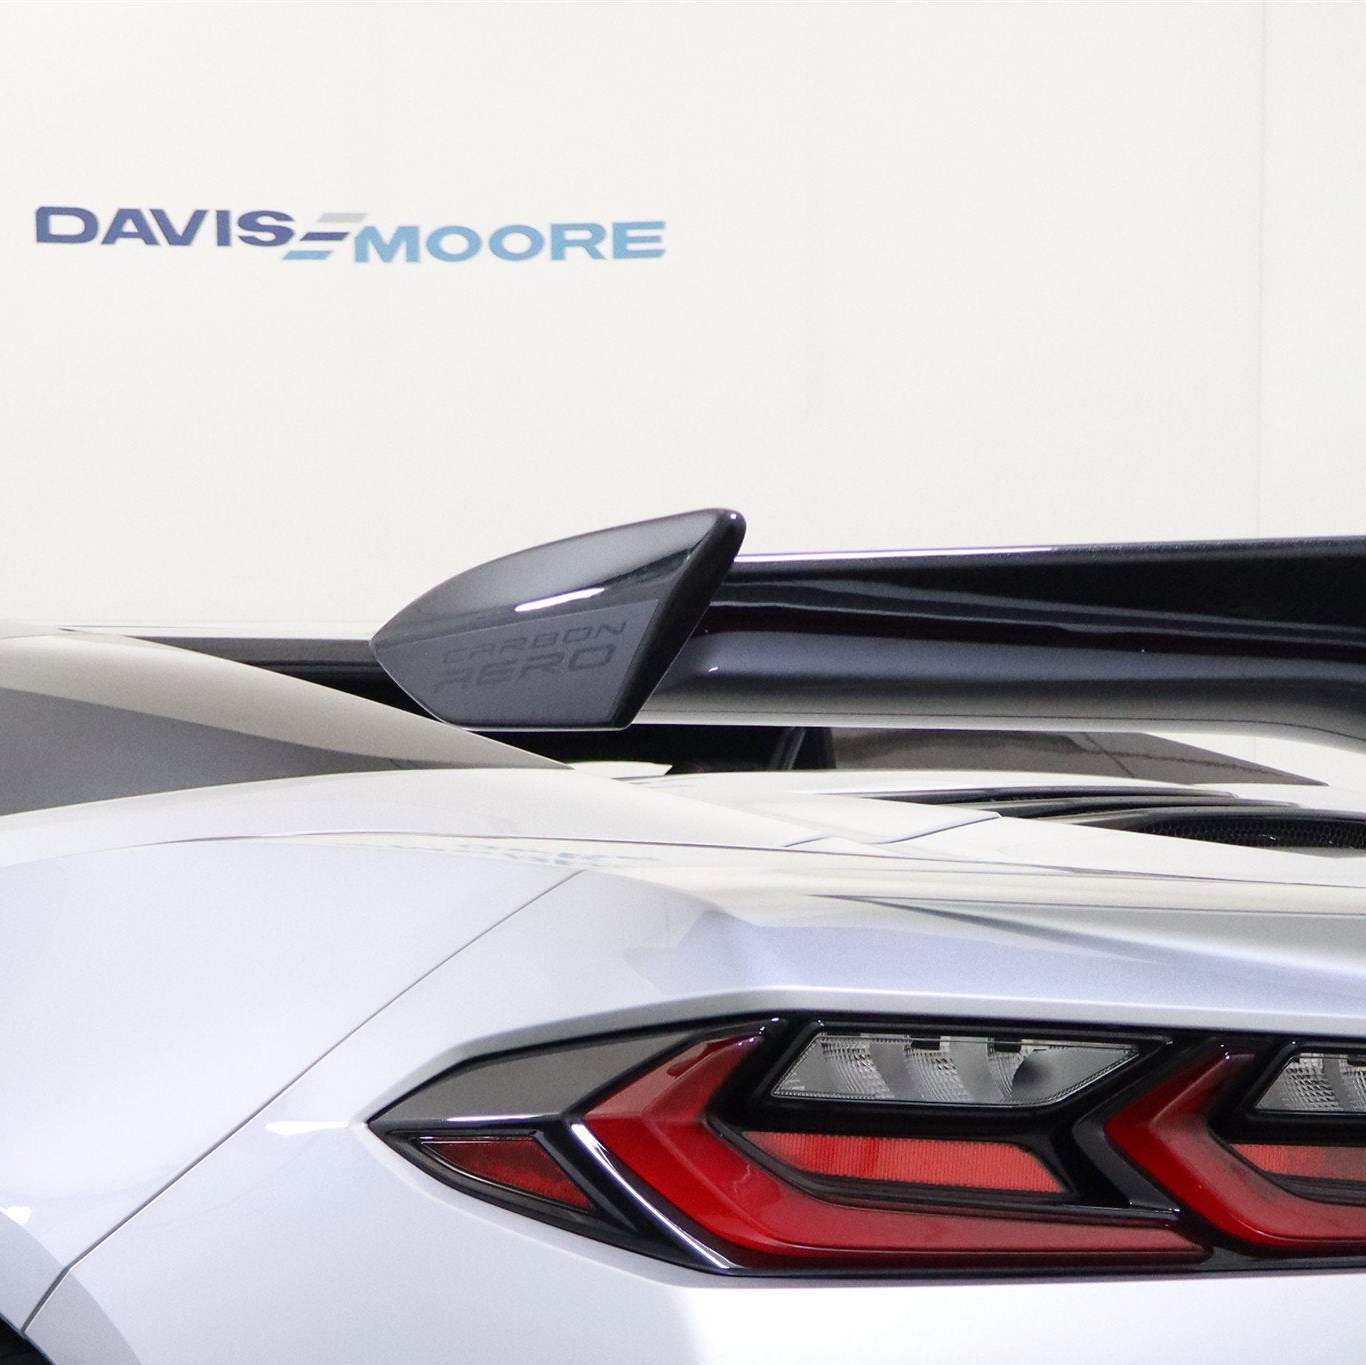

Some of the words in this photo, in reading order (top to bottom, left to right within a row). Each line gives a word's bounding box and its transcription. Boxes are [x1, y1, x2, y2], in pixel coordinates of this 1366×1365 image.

[35, 206, 295, 248] DAVIS
[354, 219, 667, 263] MOORE
[441, 620, 627, 664] CARBON
[433, 644, 617, 694] AERO
